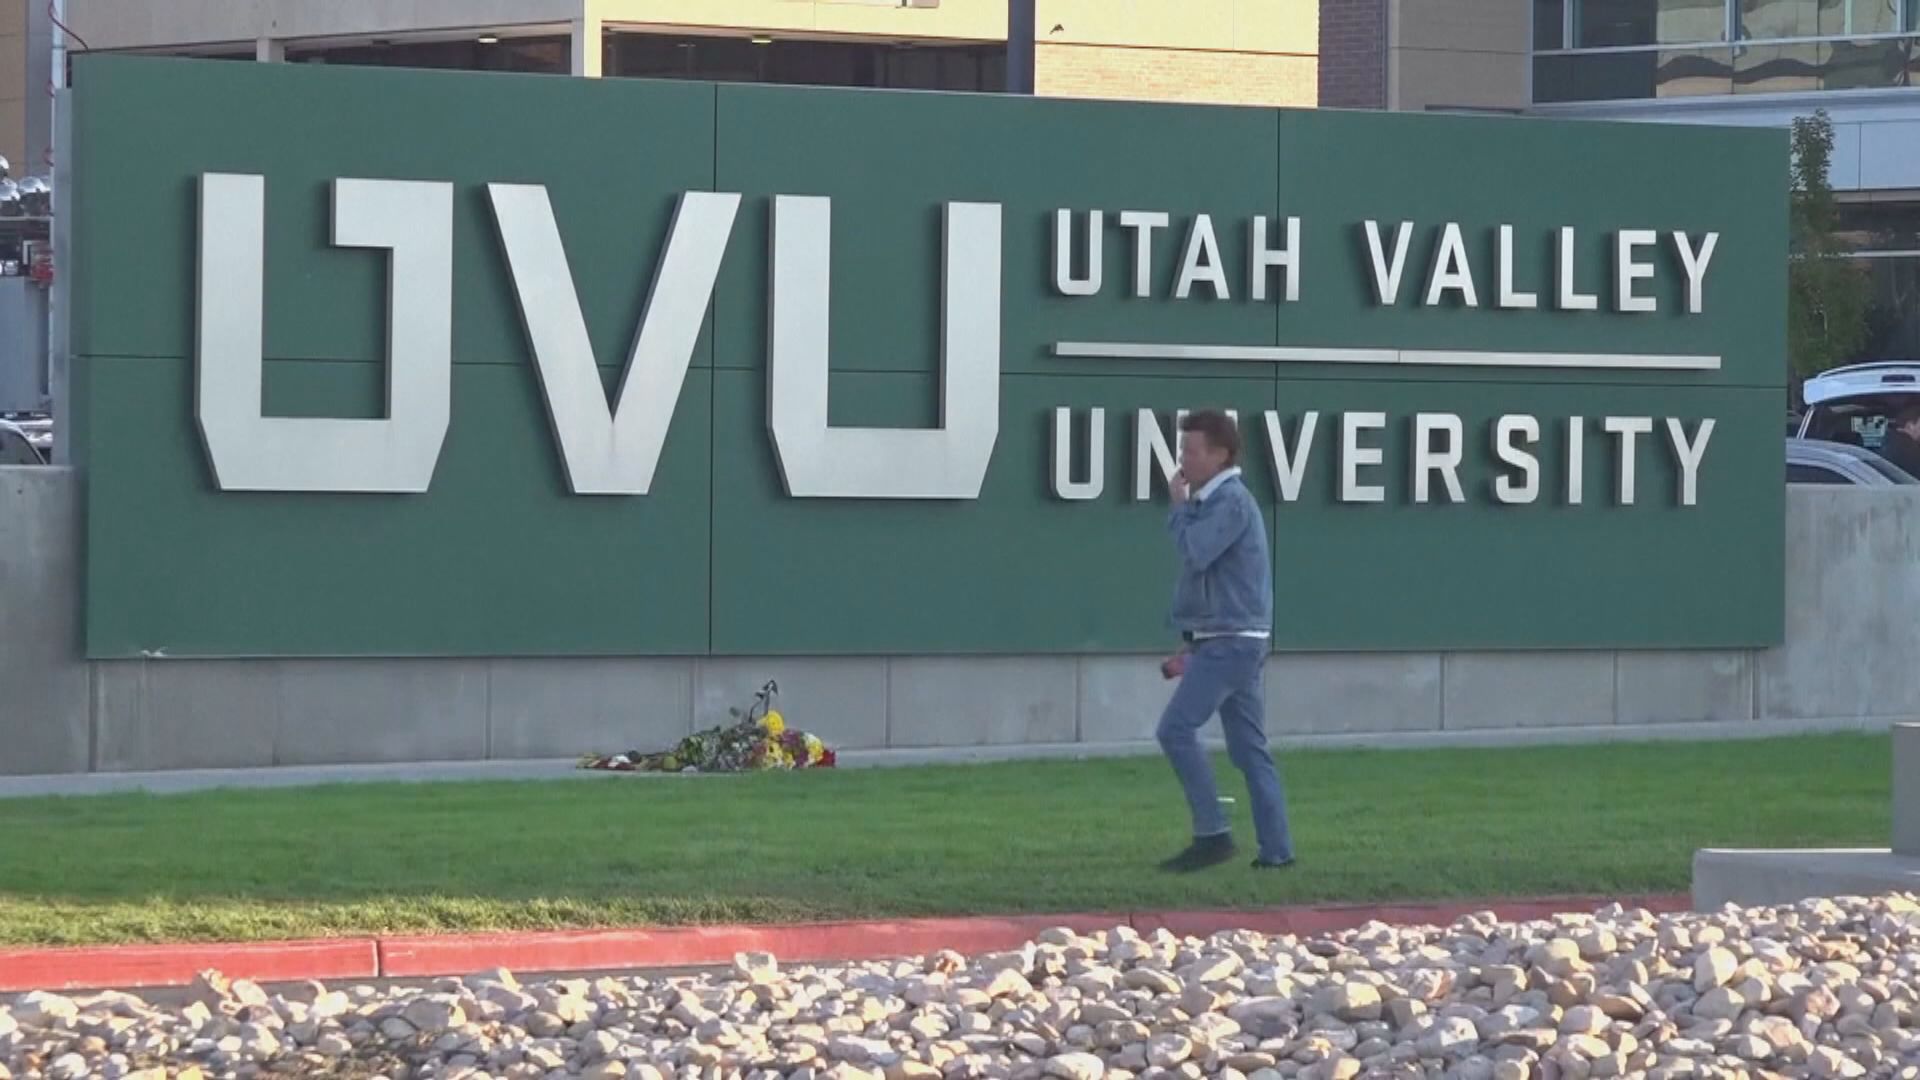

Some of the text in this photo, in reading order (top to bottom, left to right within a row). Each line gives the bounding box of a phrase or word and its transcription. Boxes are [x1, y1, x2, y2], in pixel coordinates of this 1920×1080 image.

[1055, 208, 1719, 313] UTAH VALLEY
[197, 172, 1003, 500] UVU
[1055, 406, 1717, 505] UNVERSITY
